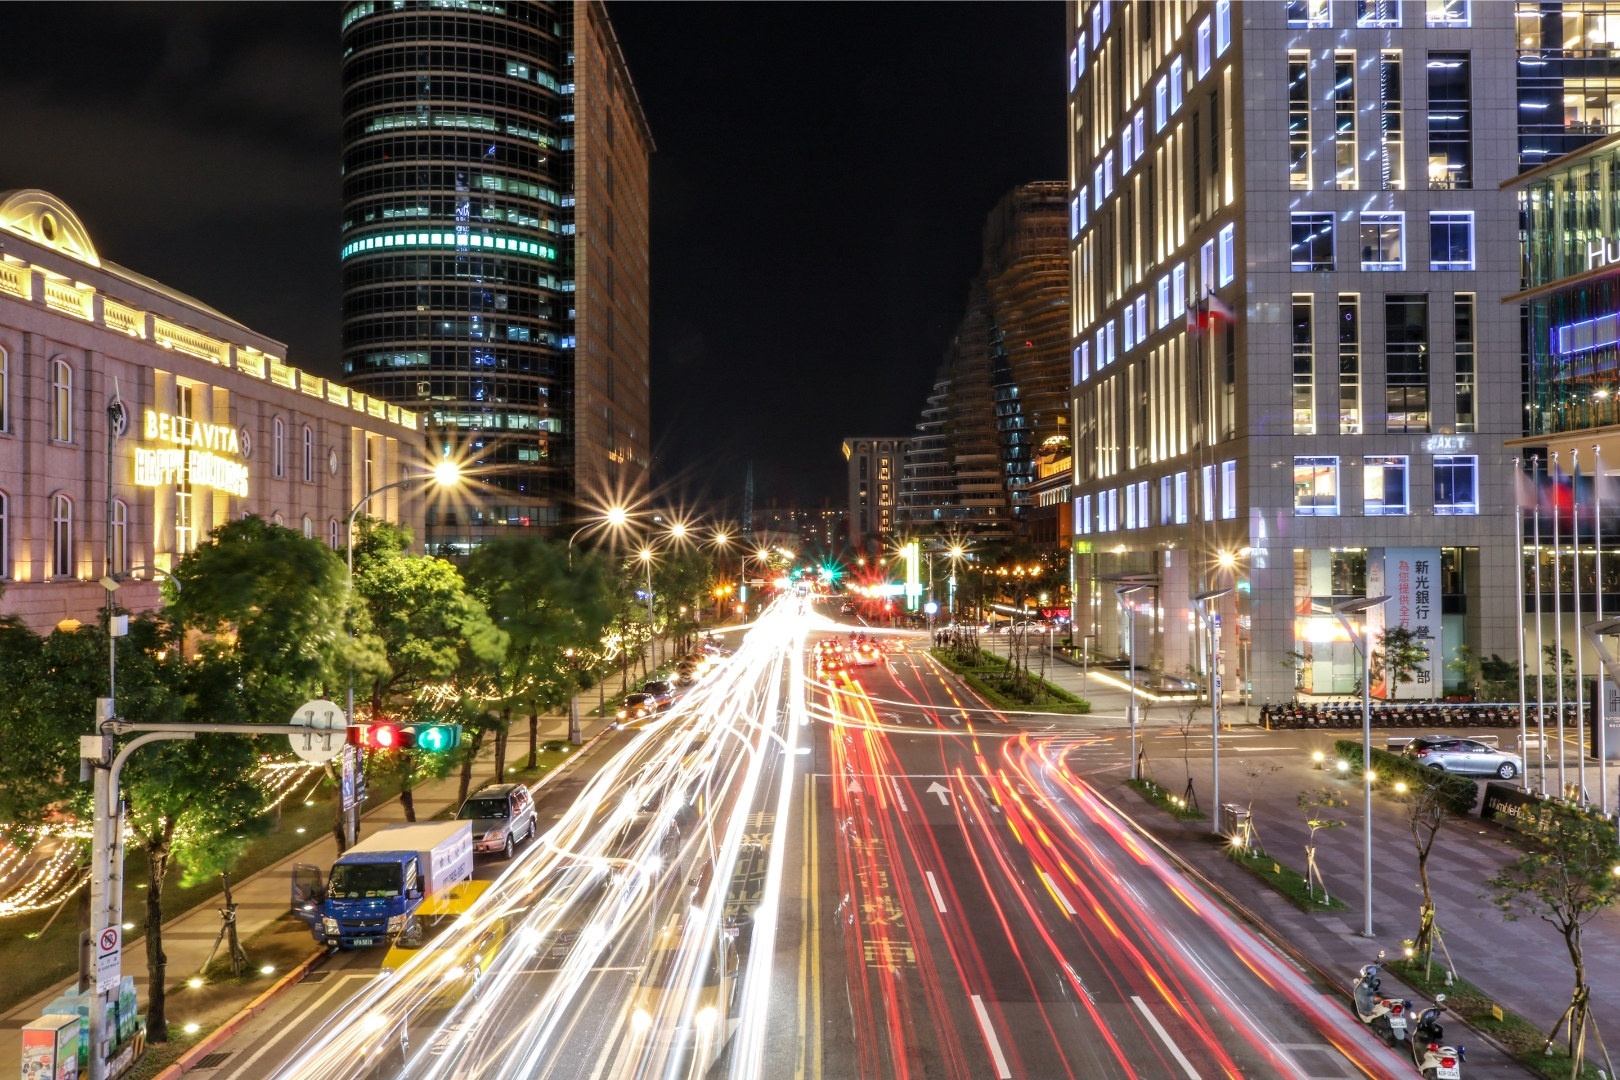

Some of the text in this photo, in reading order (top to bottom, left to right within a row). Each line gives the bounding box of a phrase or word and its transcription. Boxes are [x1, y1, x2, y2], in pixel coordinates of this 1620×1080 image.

[135, 448, 185, 486] HAPPY
[1415, 560, 1430, 620] 新光銀行
